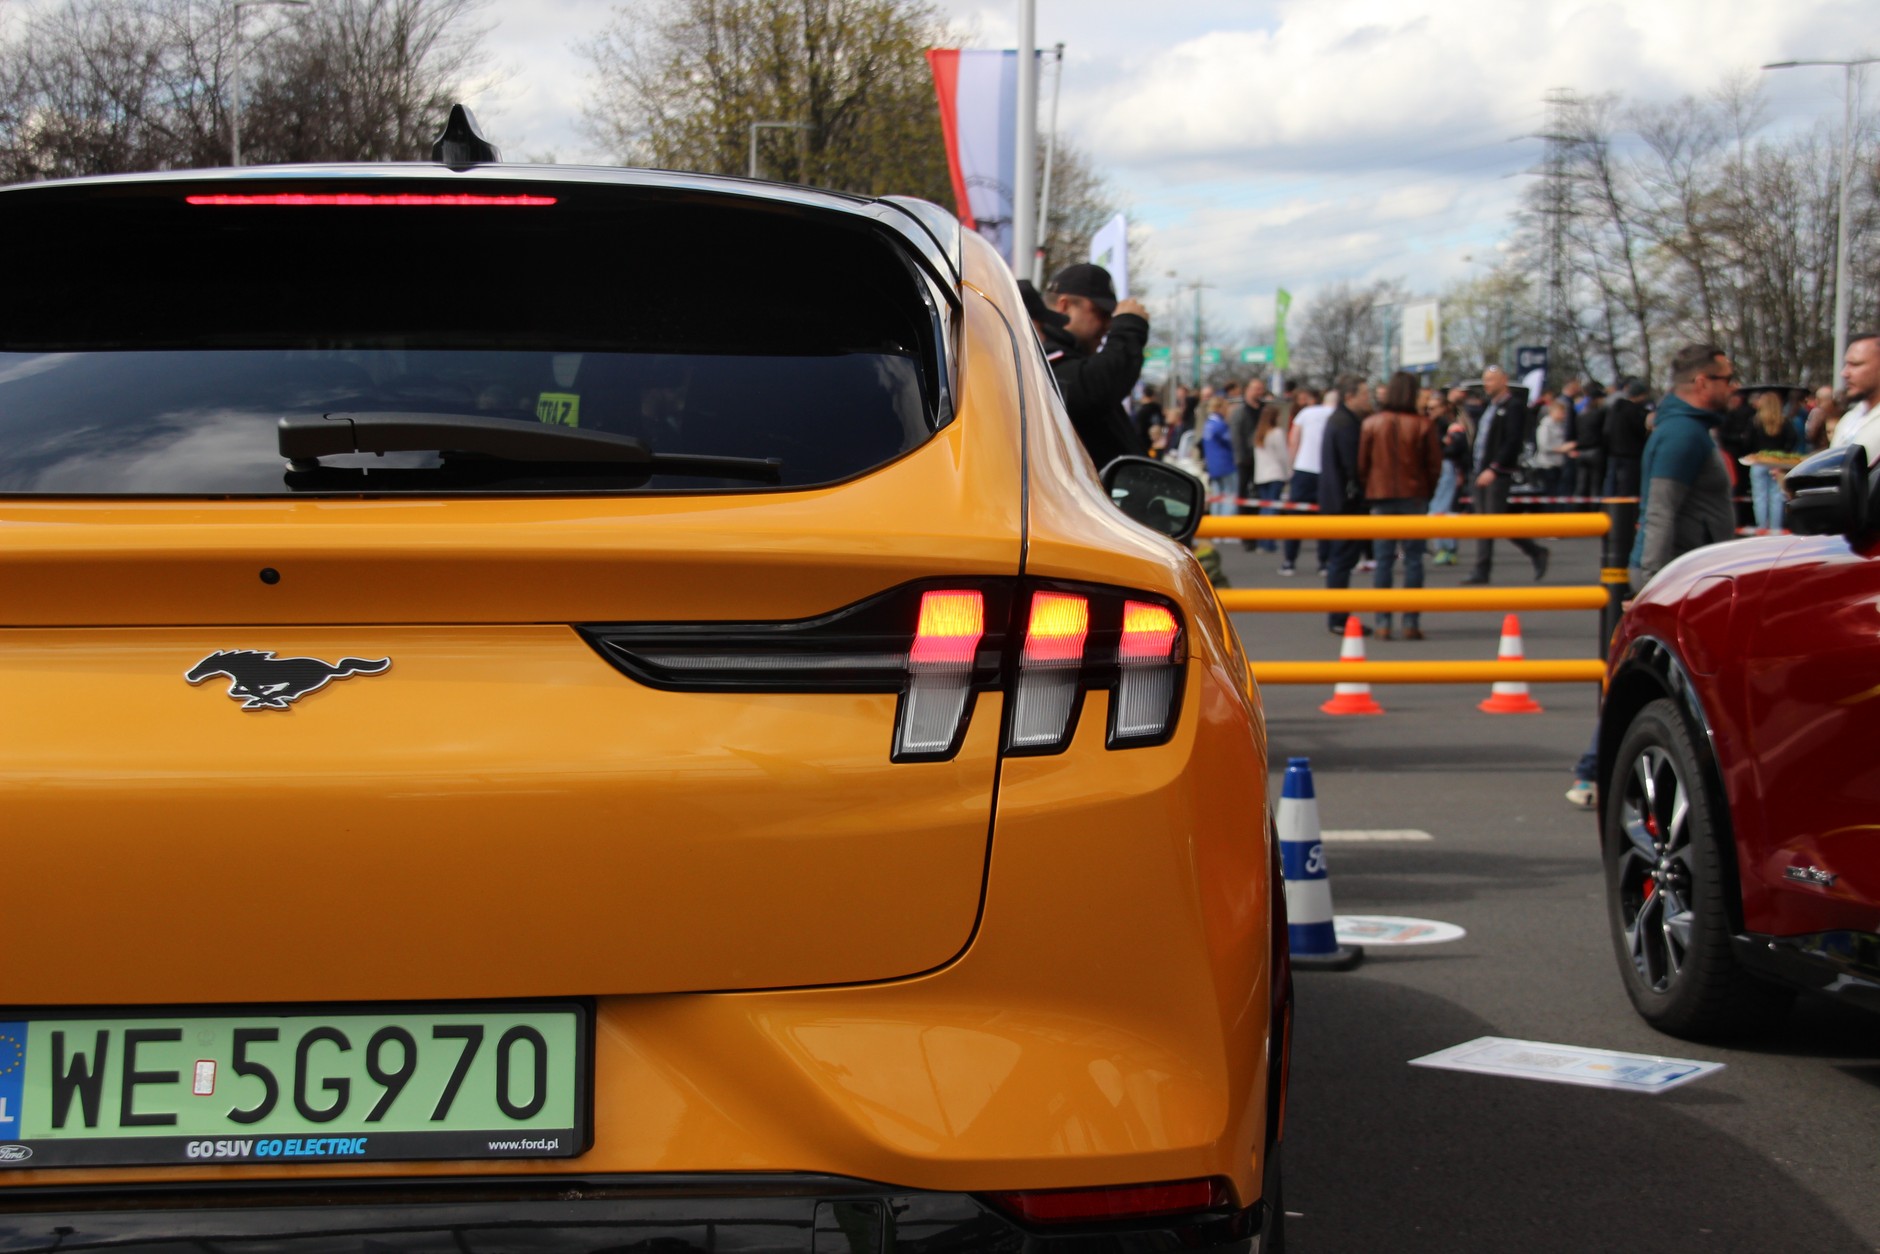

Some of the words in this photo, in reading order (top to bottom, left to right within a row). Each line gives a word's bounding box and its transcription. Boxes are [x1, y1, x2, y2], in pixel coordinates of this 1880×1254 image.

[51, 1027, 183, 1128] WE
[226, 1025, 548, 1125] 5G970
[187, 1140, 215, 1157] GO
[215, 1139, 253, 1157] SUV
[256, 1139, 283, 1157] GO
[284, 1137, 367, 1156] ELECTRIC
[488, 1138, 559, 1151] www.ford.pl
[0, 1147, 26, 1160] Ford
